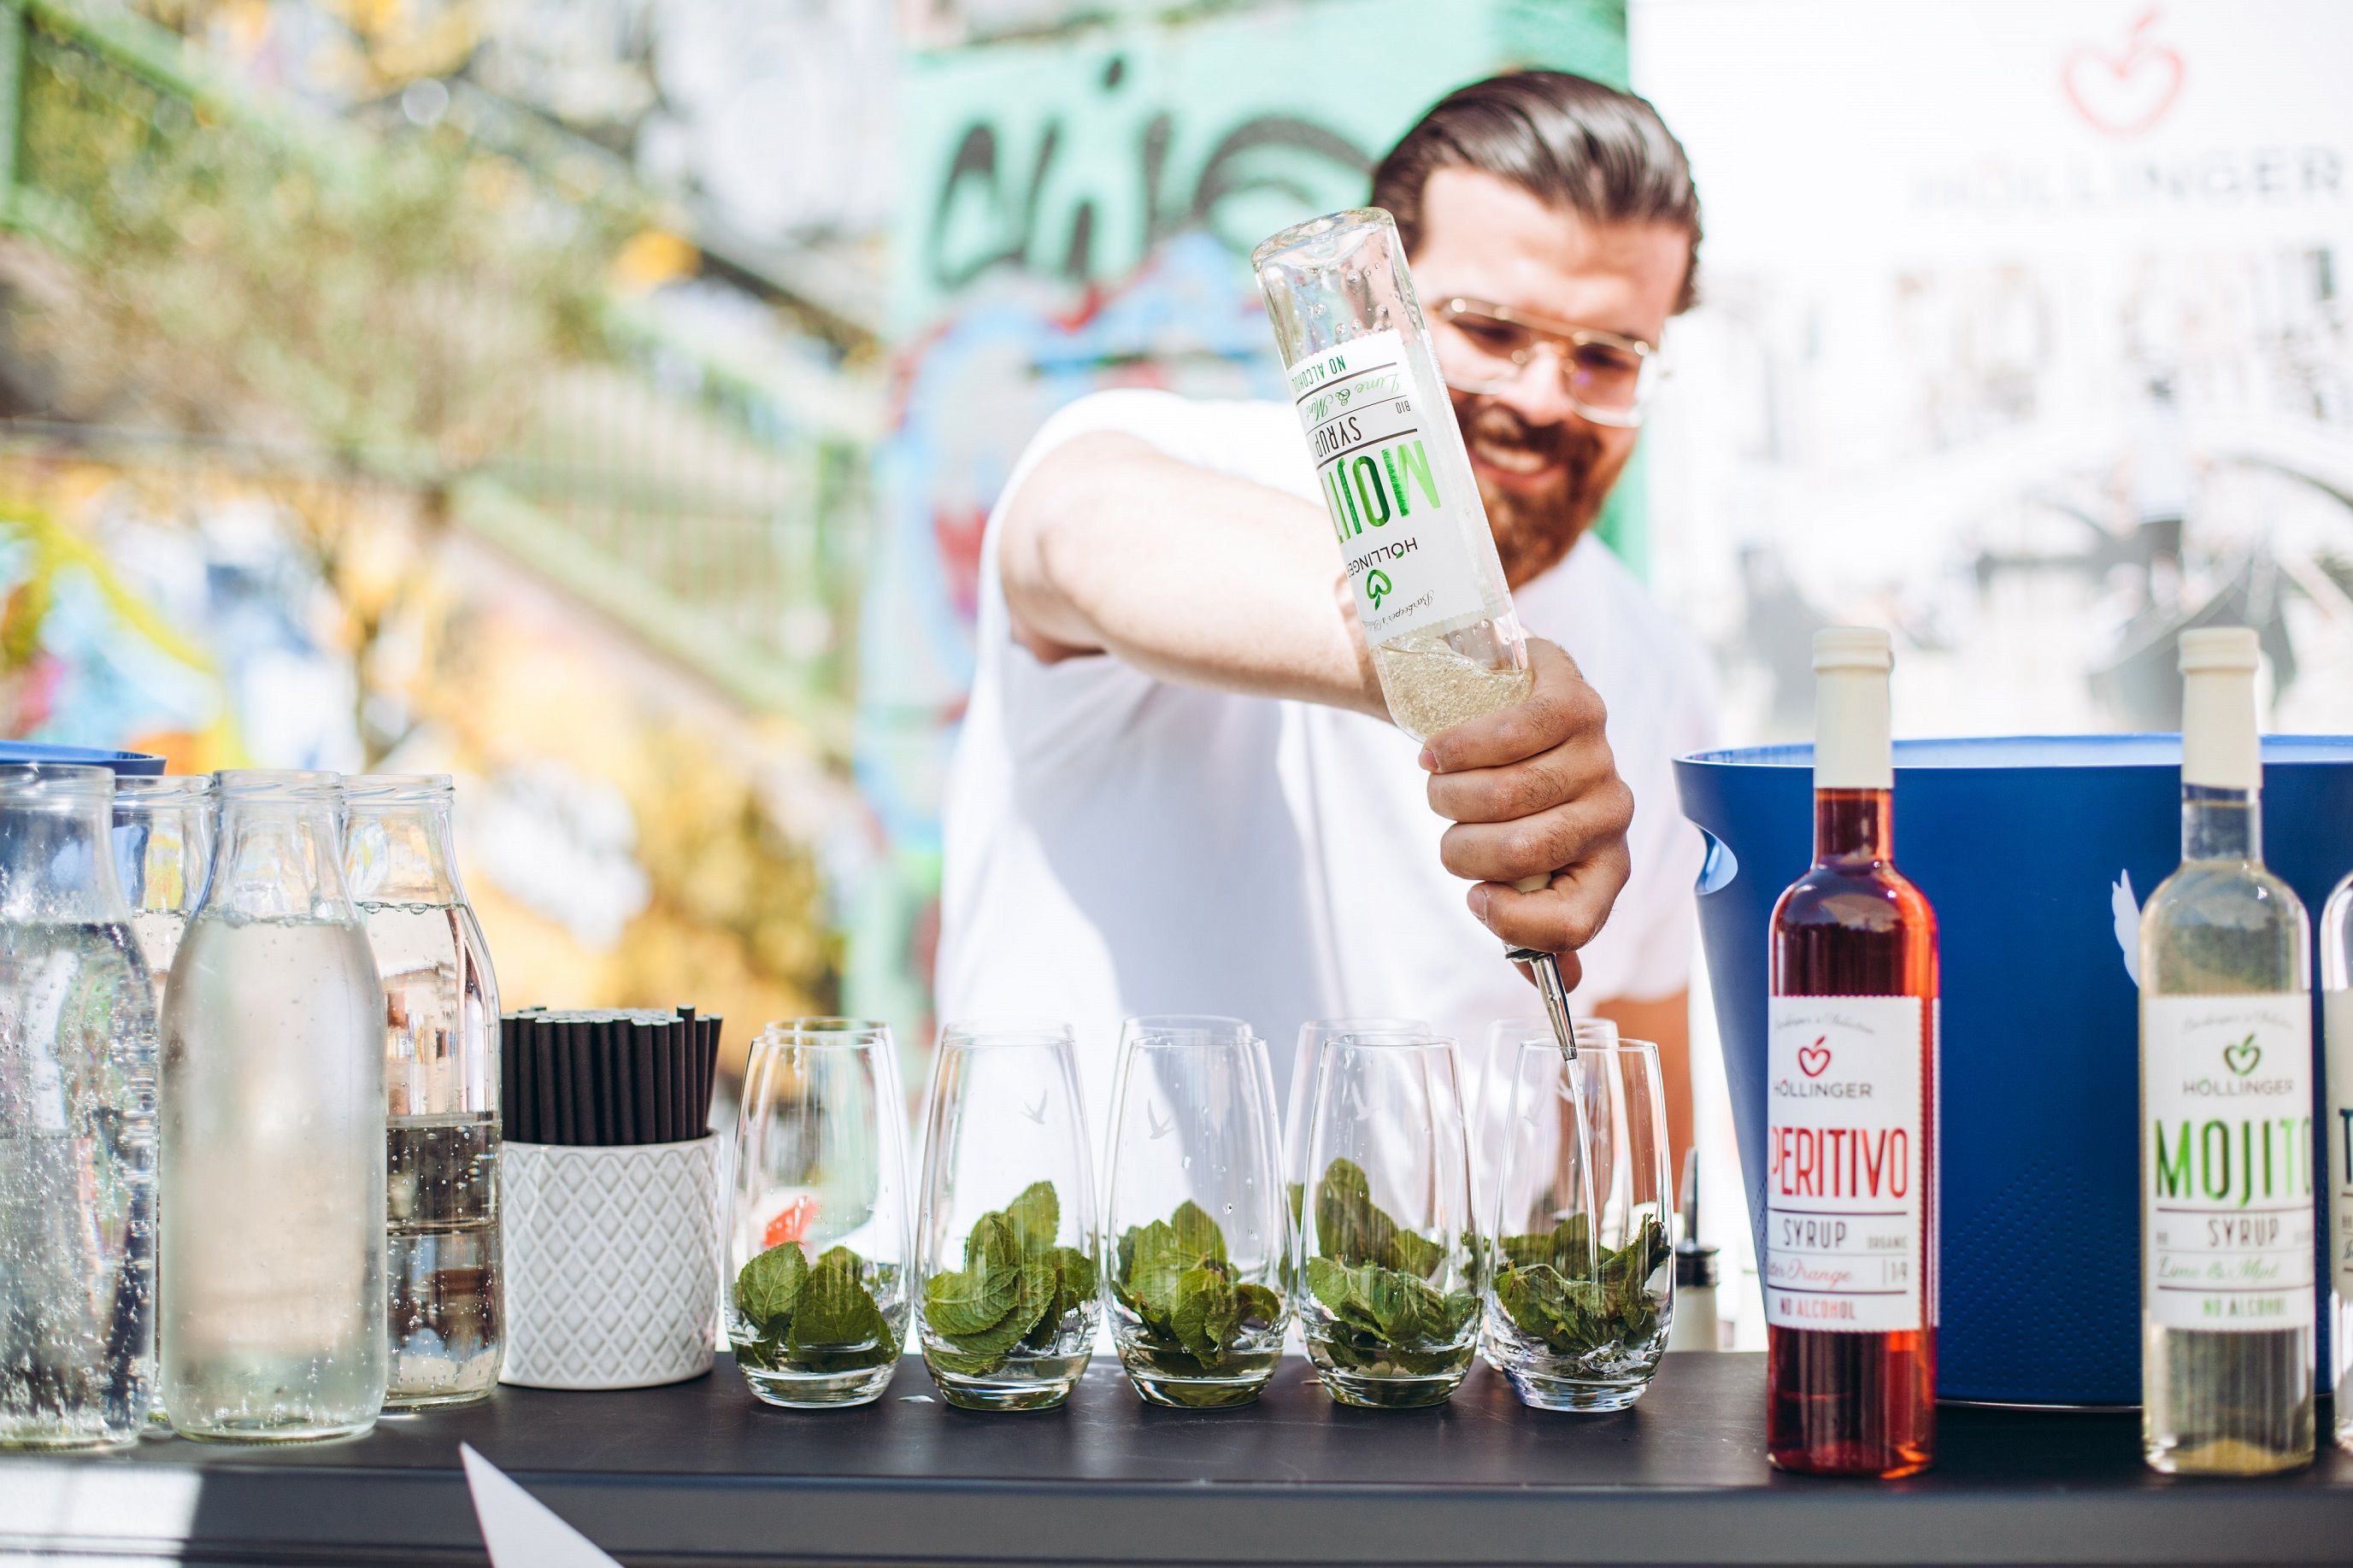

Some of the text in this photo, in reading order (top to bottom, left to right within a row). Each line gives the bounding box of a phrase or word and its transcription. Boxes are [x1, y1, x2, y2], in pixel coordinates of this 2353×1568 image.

[1291, 355, 1346, 393] NO ALCOHOL
[1306, 373, 1399, 422] Lime & Mint
[1395, 400, 1411, 414] BIO
[1315, 416, 1362, 458] SYRUP
[1381, 590, 1434, 626] Barkeeper's
[1783, 1218, 1846, 1248] SYRUP
[2208, 1218, 2279, 1248] SYRUP
[1787, 1257, 1853, 1289] Orange
[1779, 1297, 1857, 1320] NO ALCOHOL
